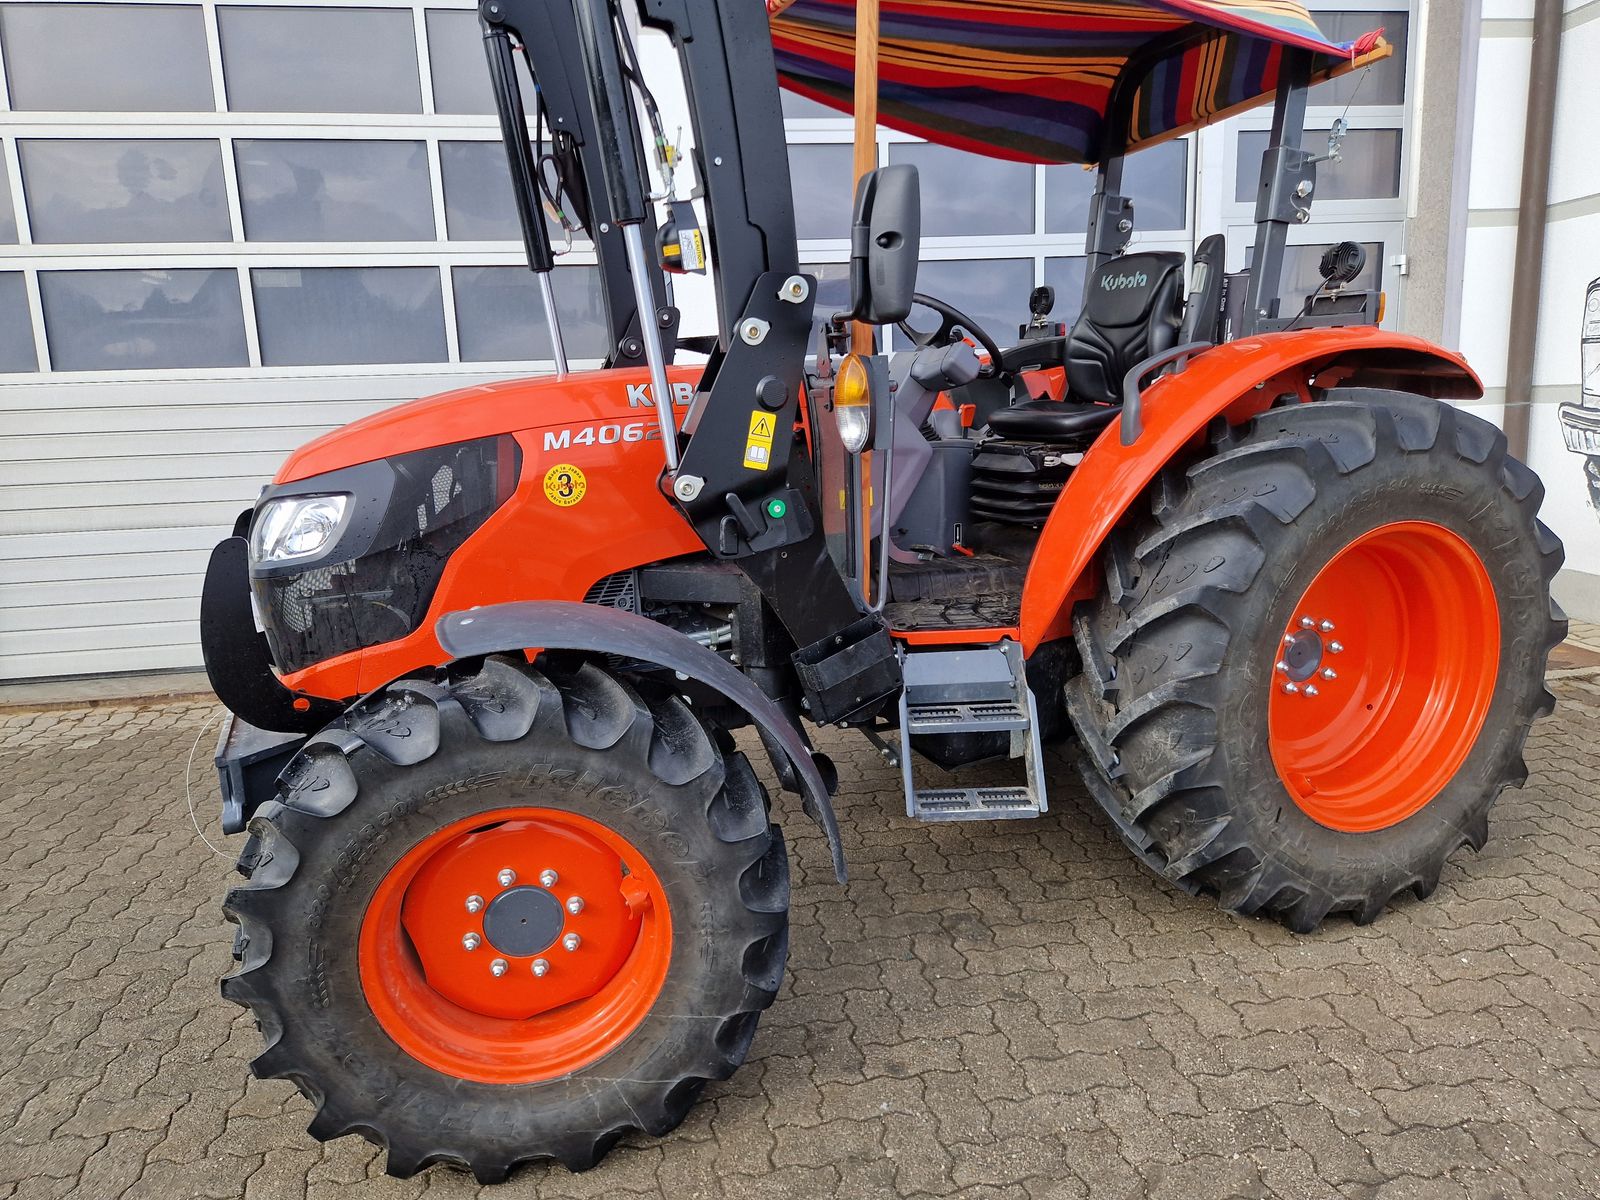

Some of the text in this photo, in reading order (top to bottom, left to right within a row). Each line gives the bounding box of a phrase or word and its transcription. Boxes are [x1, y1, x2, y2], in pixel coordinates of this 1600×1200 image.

[1101, 271, 1147, 291] Kubota
[568, 467, 582, 479] Japan
[557, 473, 574, 498] 3
